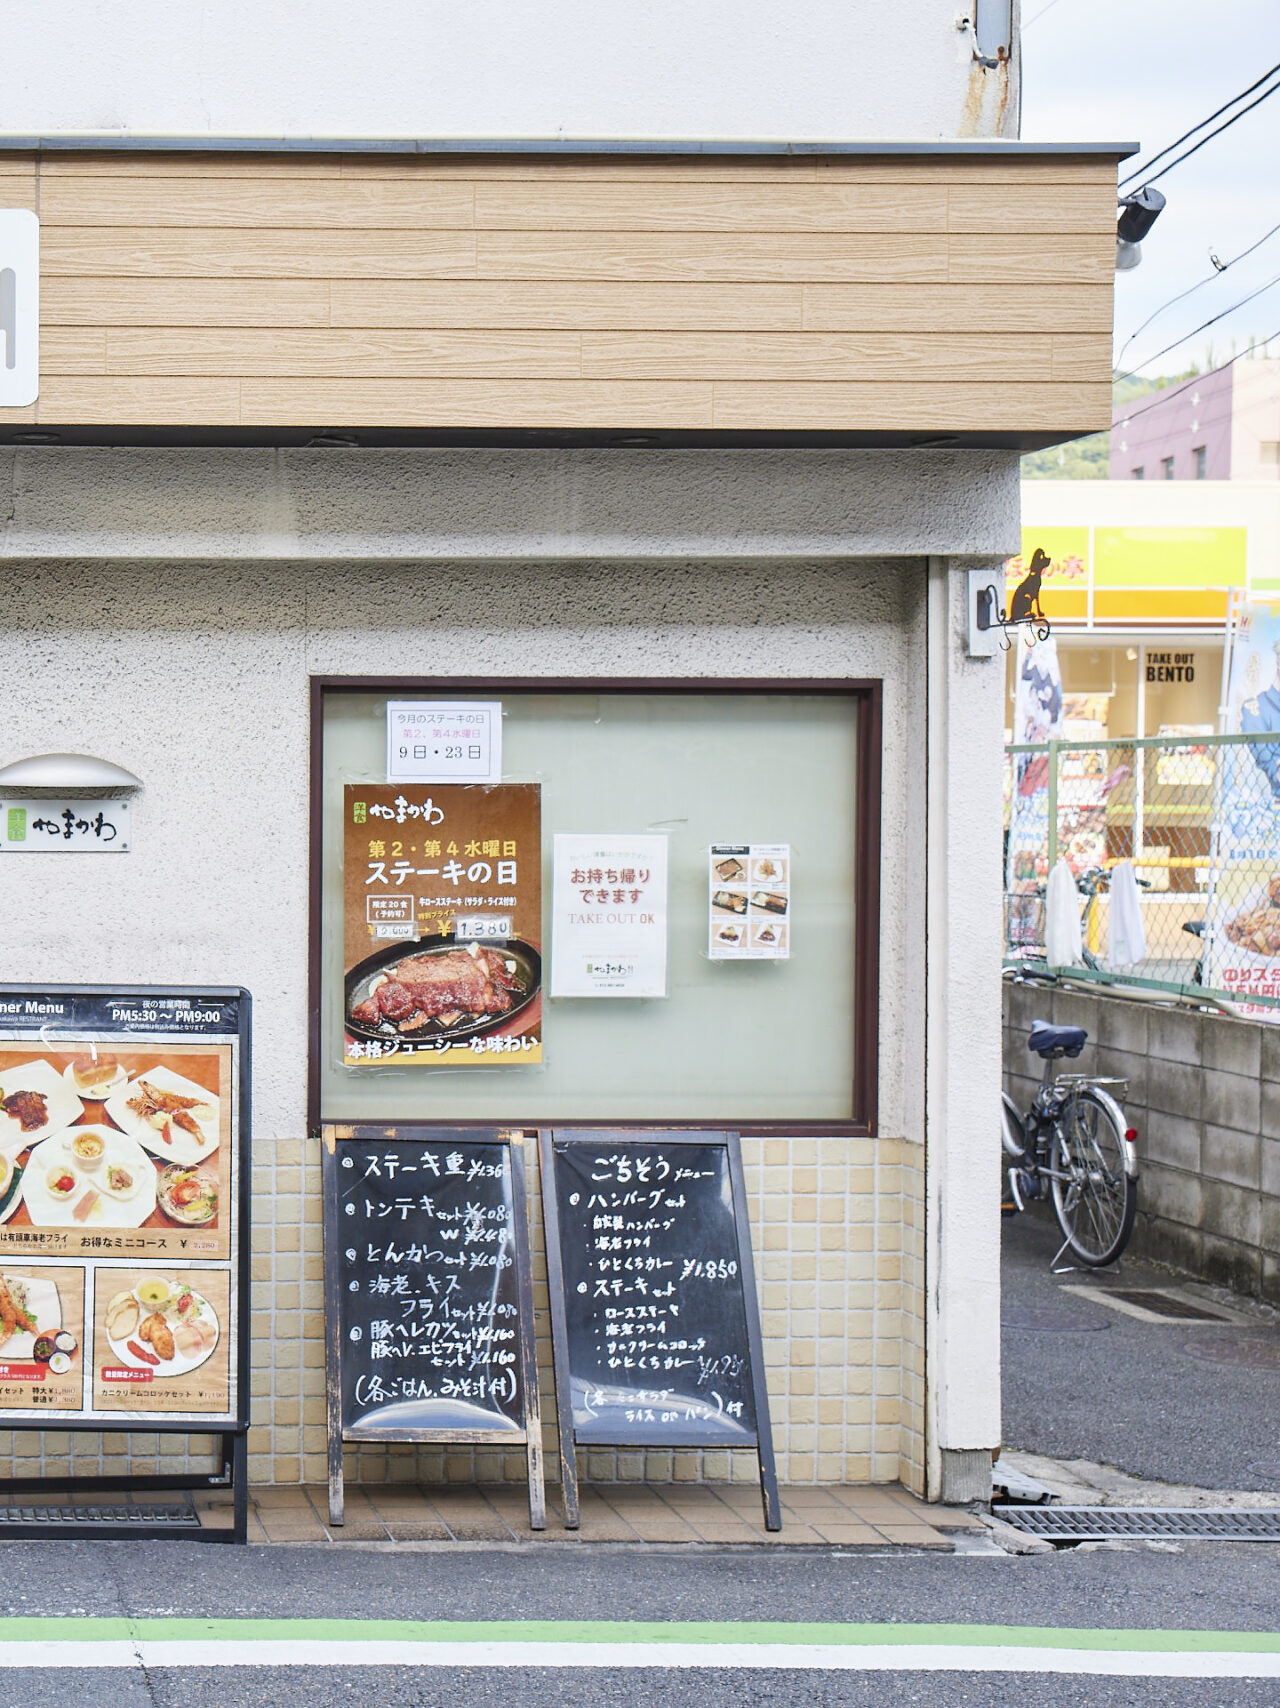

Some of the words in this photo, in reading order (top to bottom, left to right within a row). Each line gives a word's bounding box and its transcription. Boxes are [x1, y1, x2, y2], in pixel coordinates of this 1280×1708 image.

[1147, 653, 1173, 665] TAKE
[1175, 653, 1195, 665] OUT
[1146, 666, 1195, 682] BENTO
[397, 714, 484, 724] 今月のステーキの日
[369, 795, 445, 825] やまかわ
[32, 808, 117, 842] やまかわ
[368, 839, 517, 858] 第2・第4水曜日
[365, 859, 518, 885] ステーキの日
[570, 868, 651, 884] お持ち帰り
[579, 888, 644, 904] できます
[568, 913, 603, 924] TAKE
[606, 913, 637, 924] OUT
[640, 913, 655, 924] OK
[25, 1001, 64, 1014] Menu
[142, 1000, 191, 1009] 夜の営業時間
[112, 1009, 157, 1021] PM5:30
[175, 1010, 220, 1022] PM9:00
[347, 1035, 539, 1060] 本格ジューシーな味わい
[364, 1151, 466, 1179] ステーキ重
[591, 1155, 670, 1182] ごちそう
[674, 1168, 715, 1182] メニュー
[587, 1188, 666, 1209] ハンバーグ
[365, 1194, 435, 1220] トンテキ
[80, 1237, 168, 1249] お得なミニコース
[594, 1235, 651, 1251] 海老フライ
[366, 1241, 444, 1264] とんかつ
[598, 1257, 673, 1272] ひとくちカレー
[593, 1276, 648, 1298] ステーキ
[399, 1296, 451, 1320] フライ
[608, 1355, 694, 1370] ひとくちカレー
[102, 1389, 192, 1398] カニクリームコロッケセット
